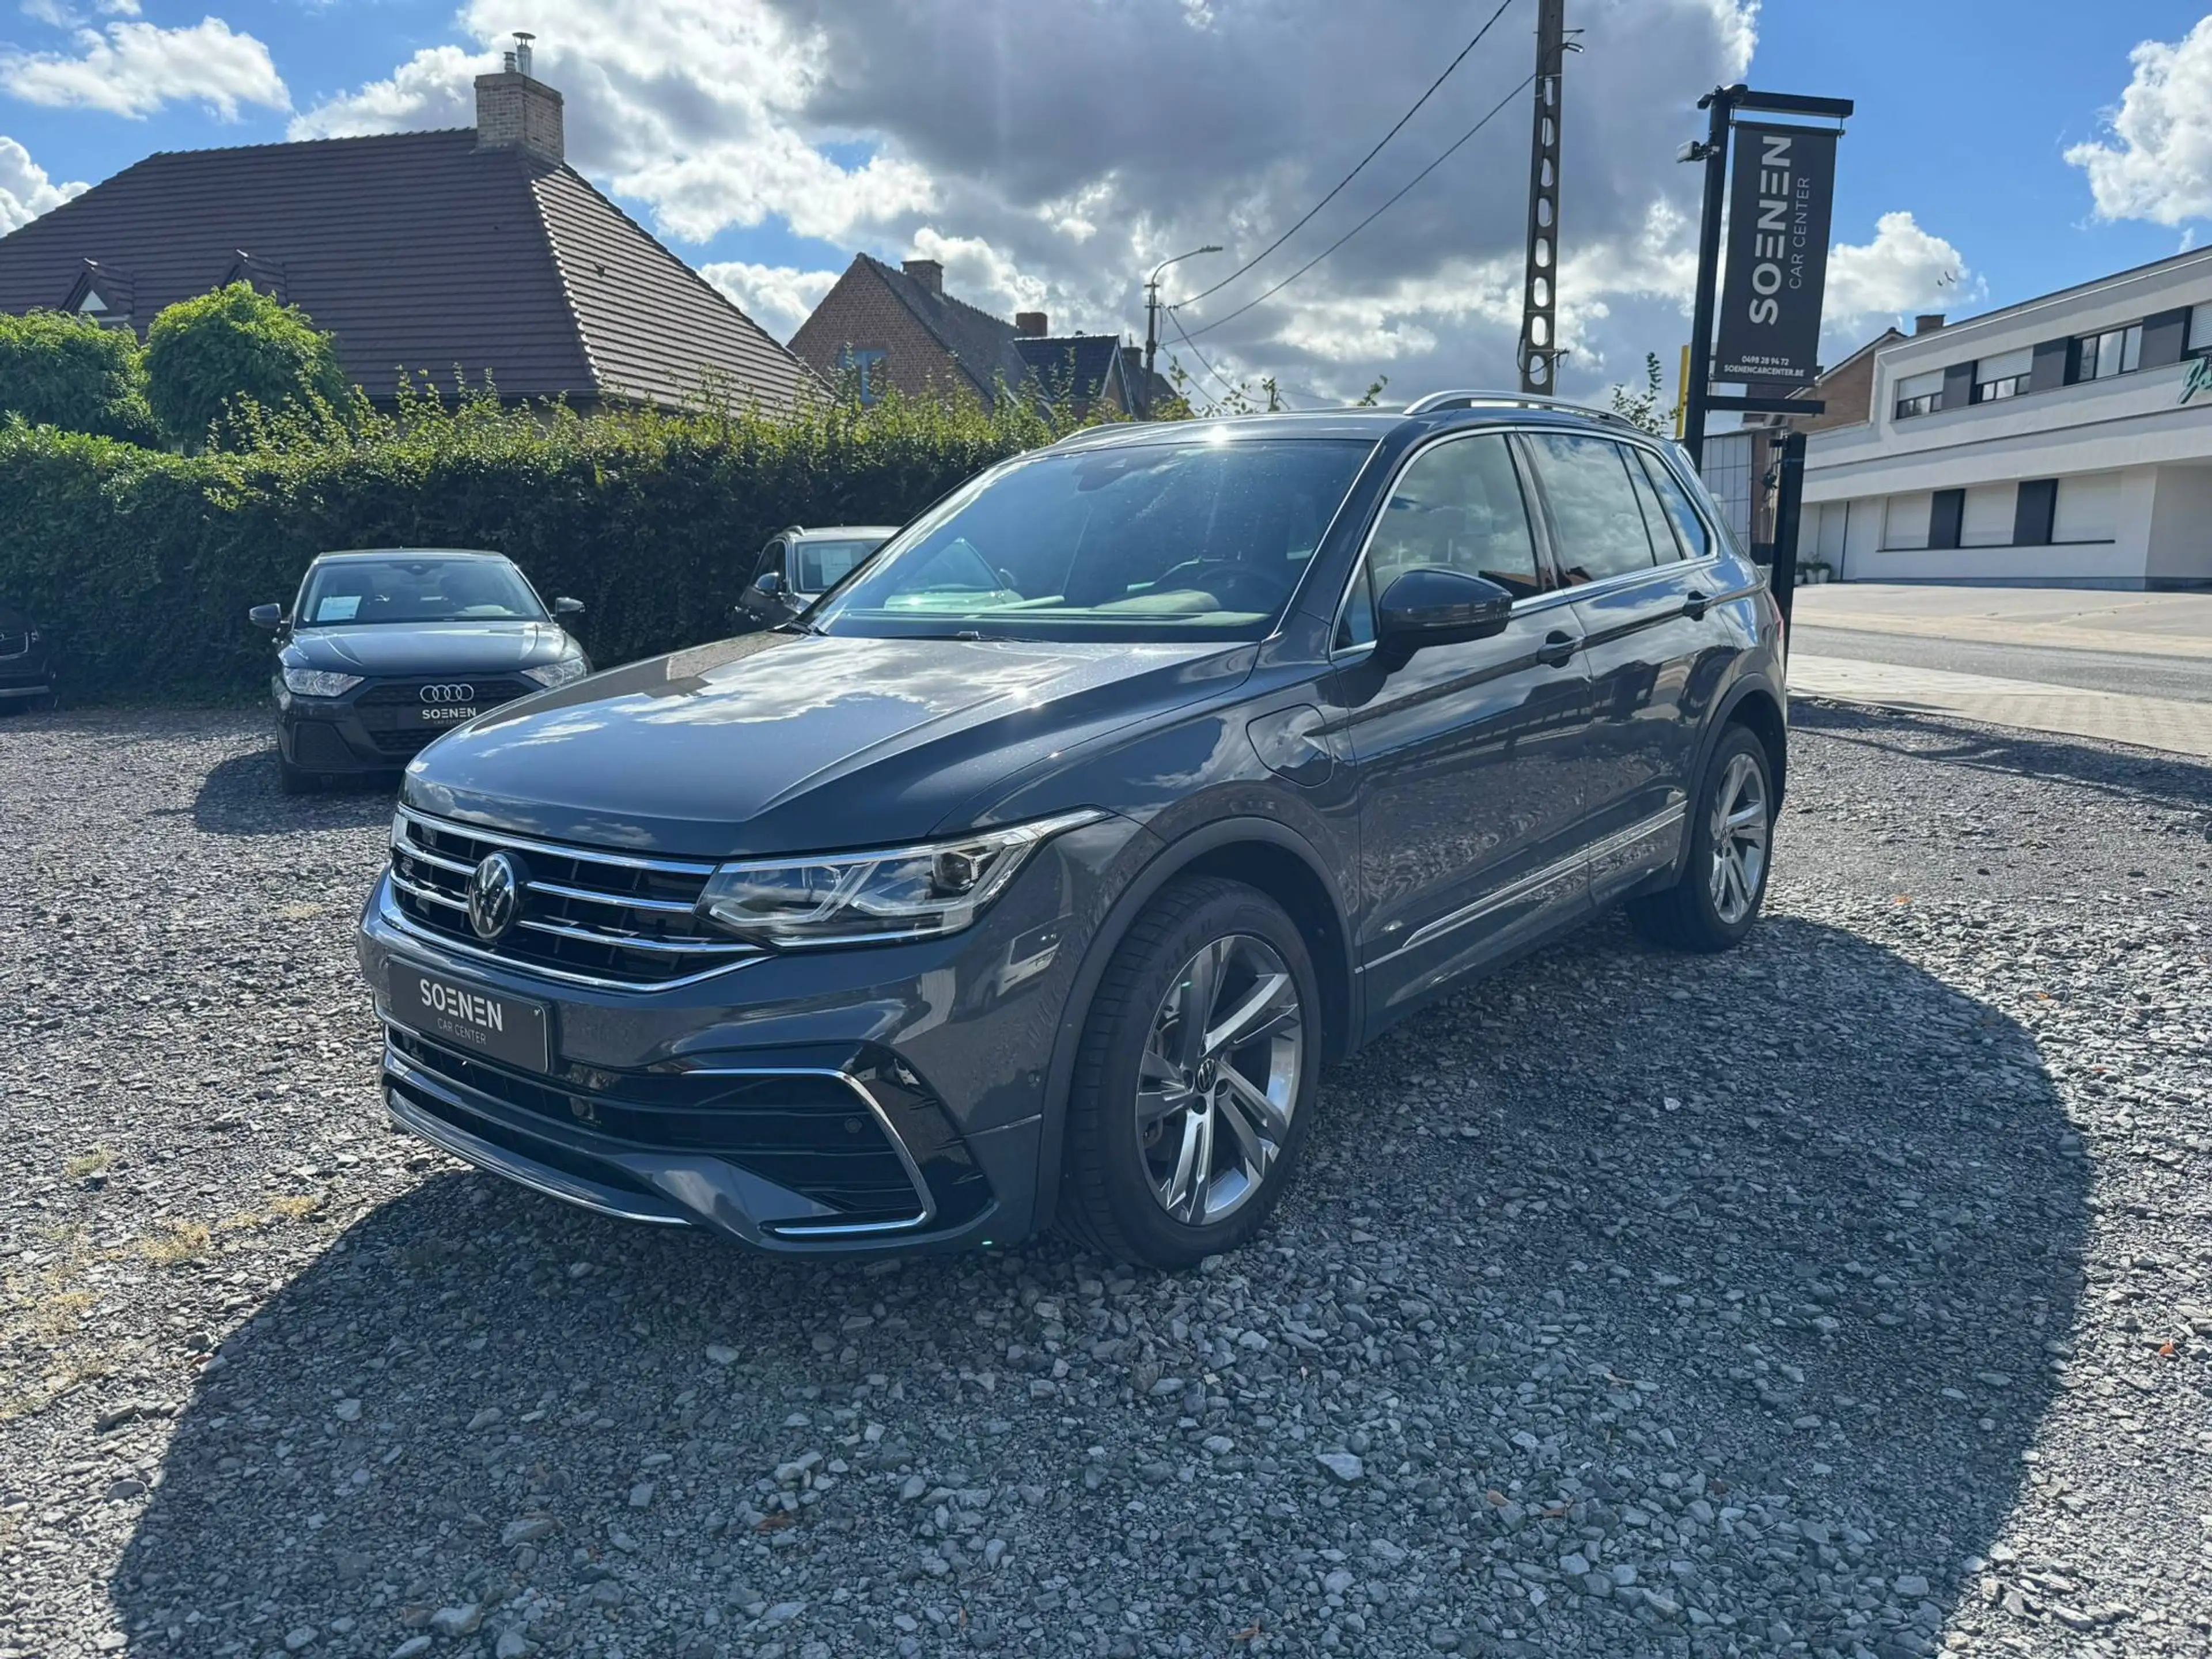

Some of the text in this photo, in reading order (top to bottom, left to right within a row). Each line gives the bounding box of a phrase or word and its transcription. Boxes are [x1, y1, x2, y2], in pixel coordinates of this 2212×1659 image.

[1749, 135, 1792, 326] SOENEN
[1789, 177, 1810, 290] CAR CENTER
[422, 707, 476, 719] SOENEN
[420, 978, 503, 1032] SOENEN
[437, 1017, 487, 1045] CAR CENTER
